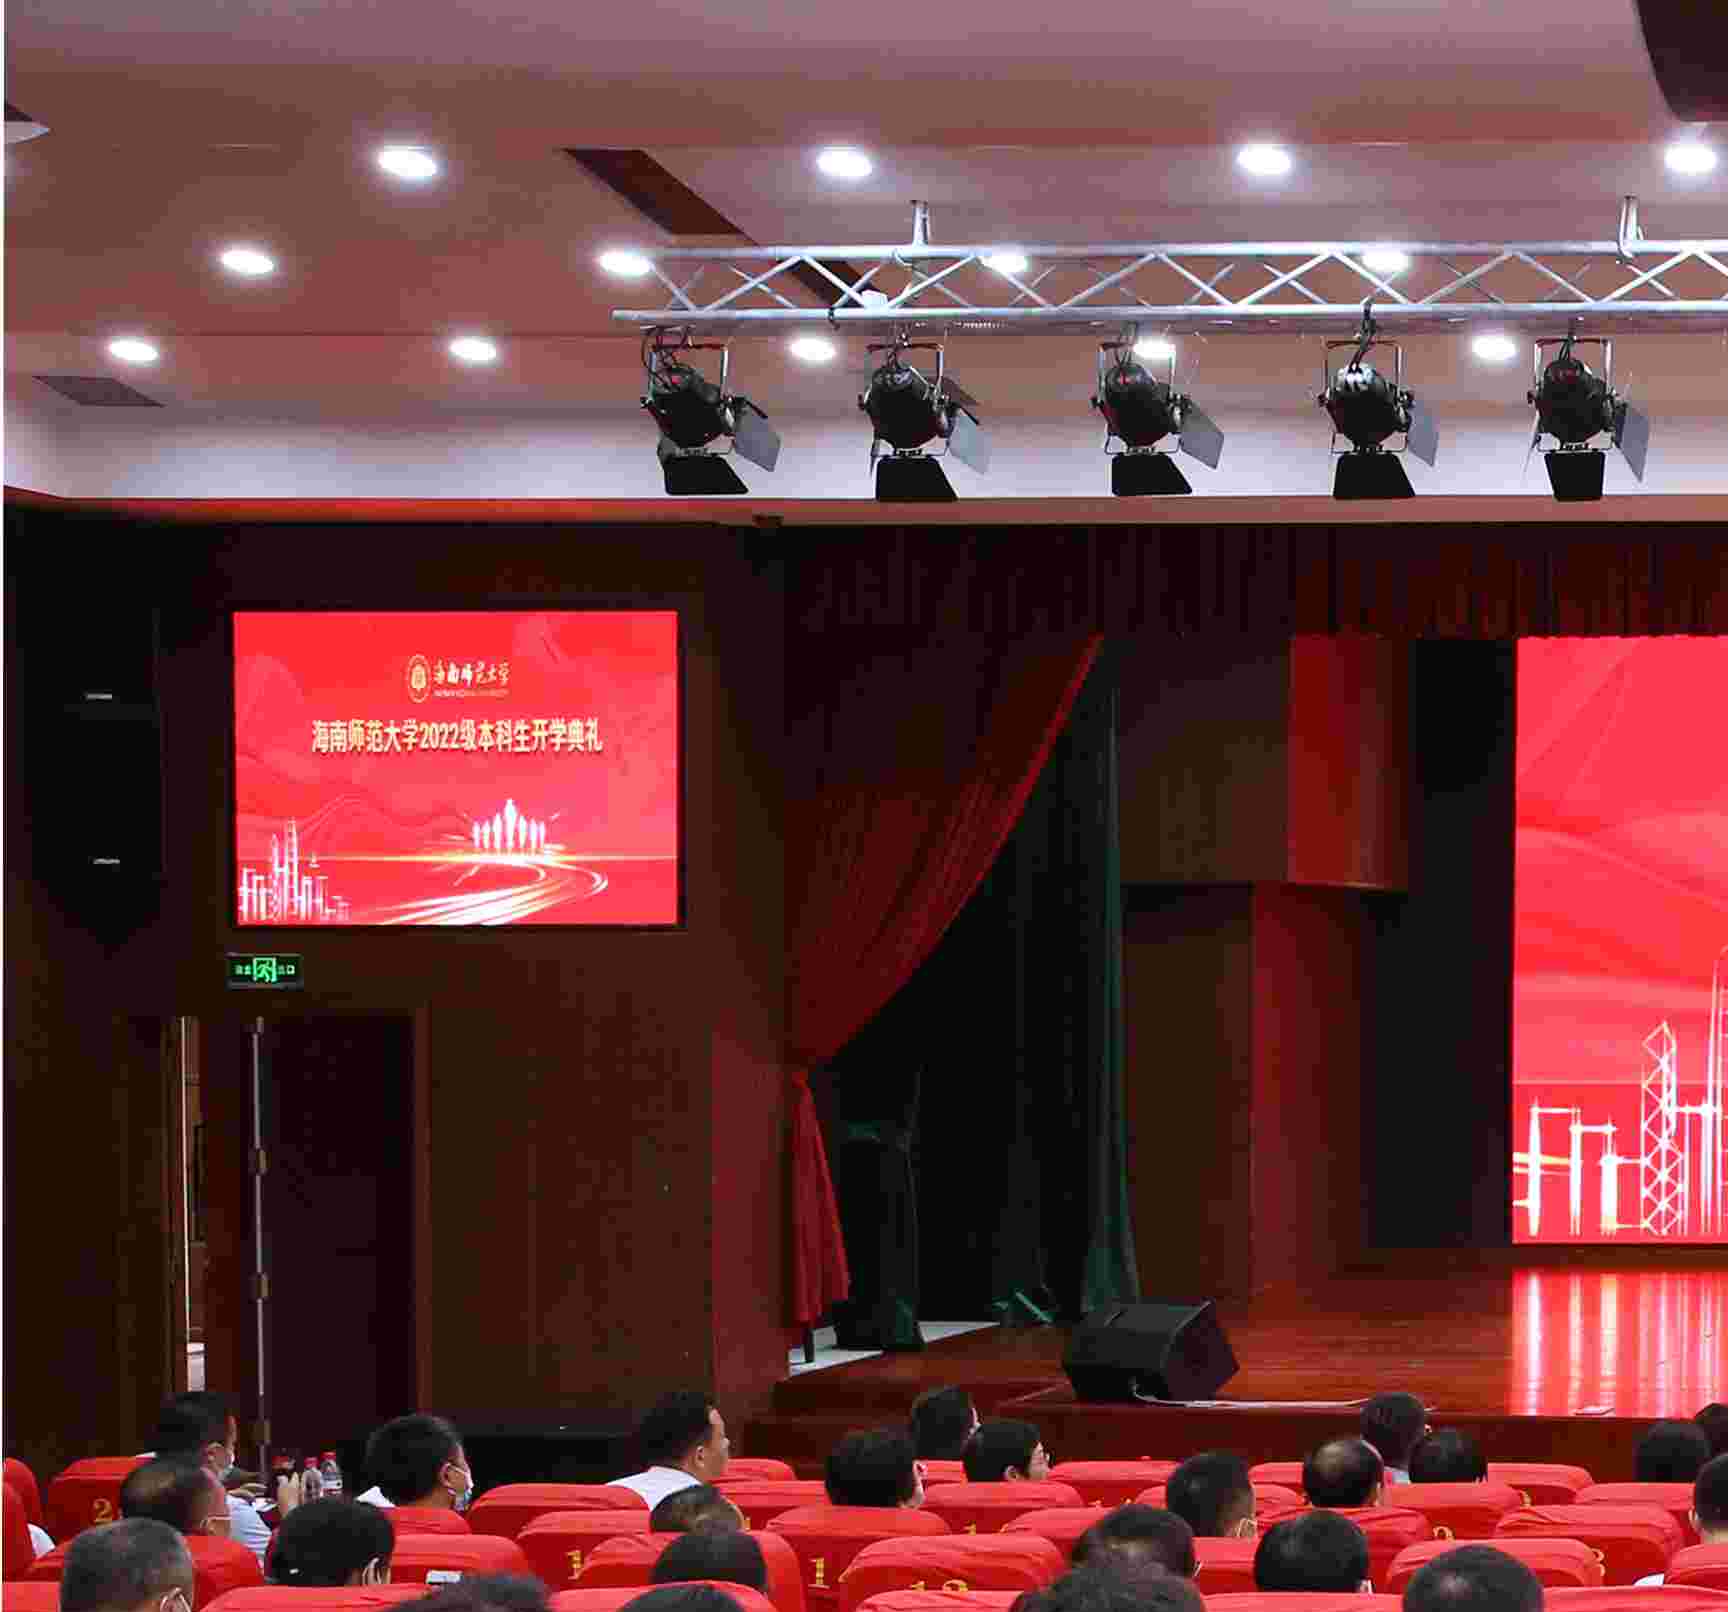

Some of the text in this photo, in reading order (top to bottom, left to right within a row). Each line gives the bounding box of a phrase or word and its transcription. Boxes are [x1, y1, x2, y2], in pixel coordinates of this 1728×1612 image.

[311, 717, 604, 753] 海南师范大学2022级本科生开学典礼
